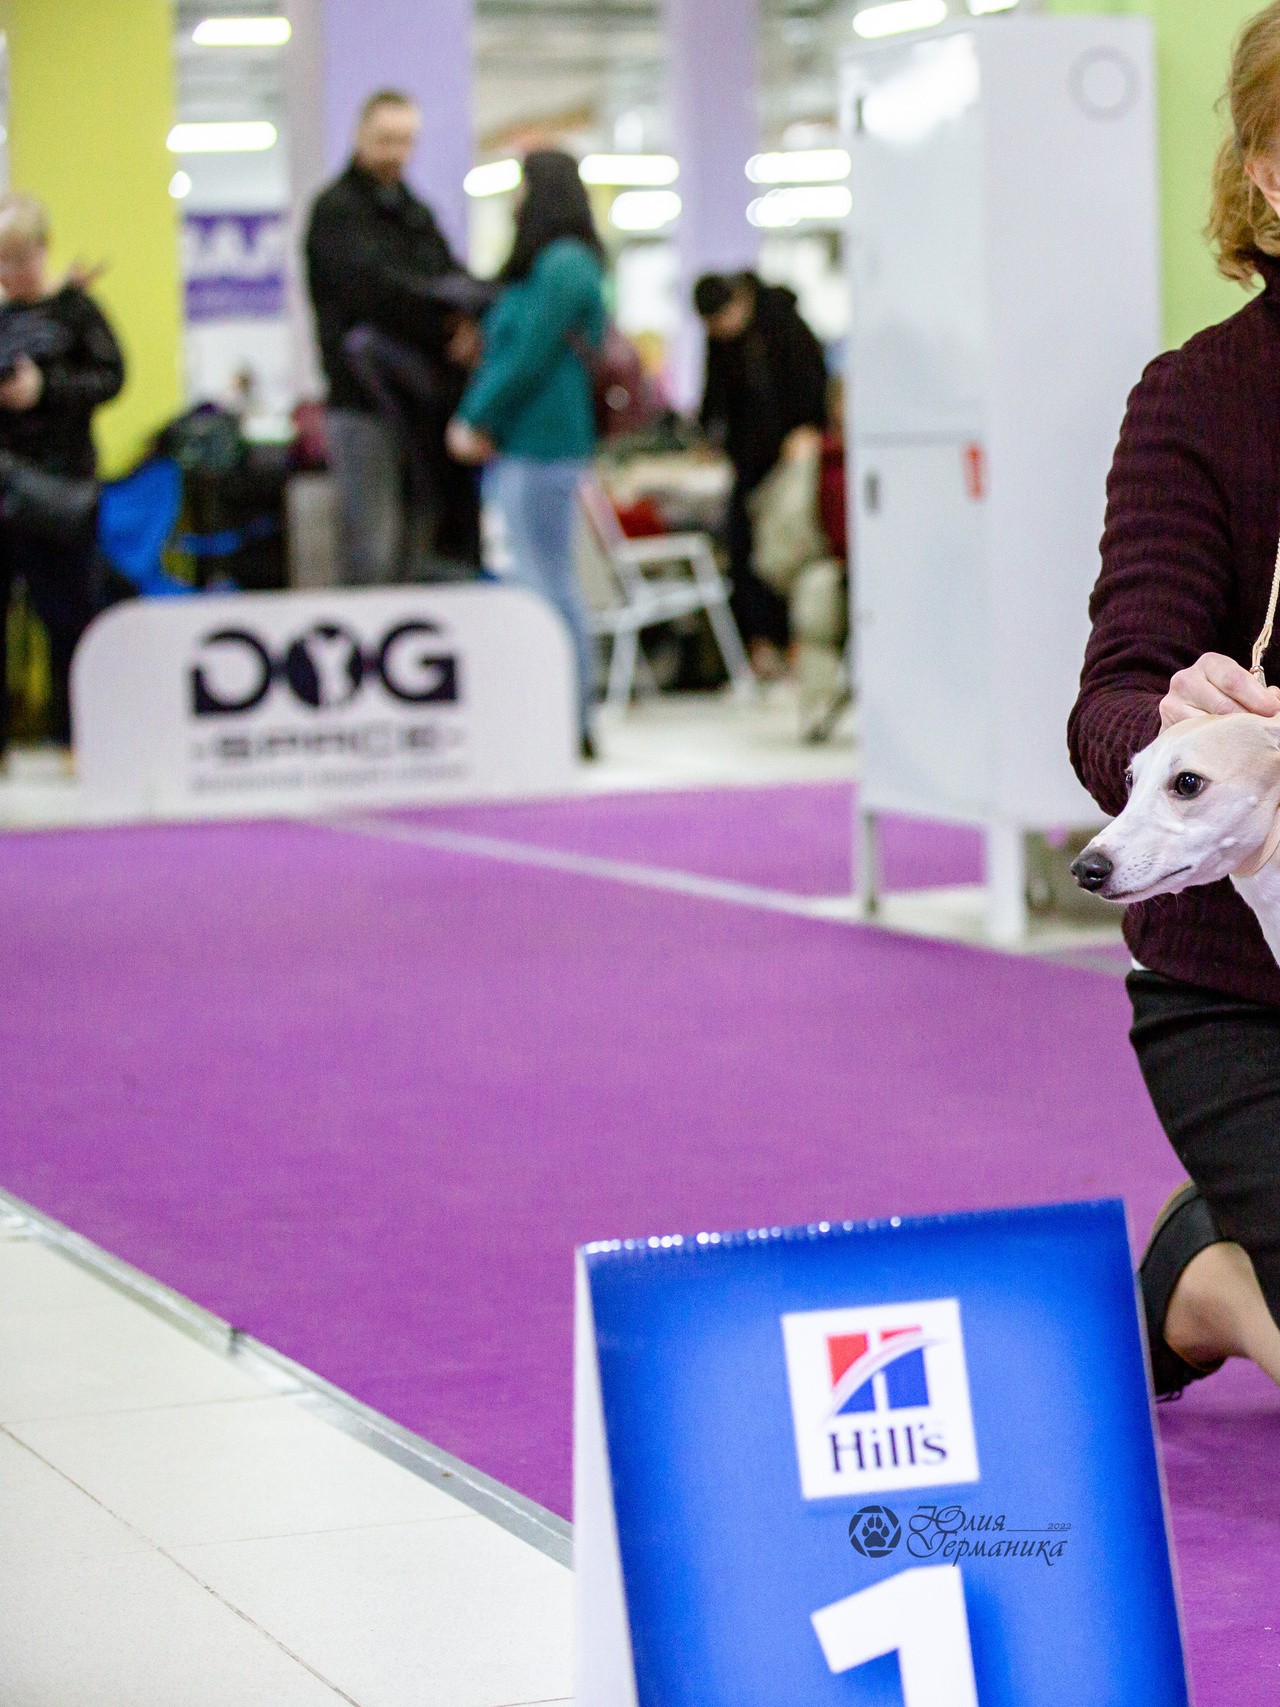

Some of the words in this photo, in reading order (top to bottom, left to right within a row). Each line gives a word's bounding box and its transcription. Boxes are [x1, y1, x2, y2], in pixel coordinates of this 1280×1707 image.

[192, 621, 457, 713] DOG
[828, 1423, 948, 1474] Hill's
[810, 1563, 979, 1707] 1
